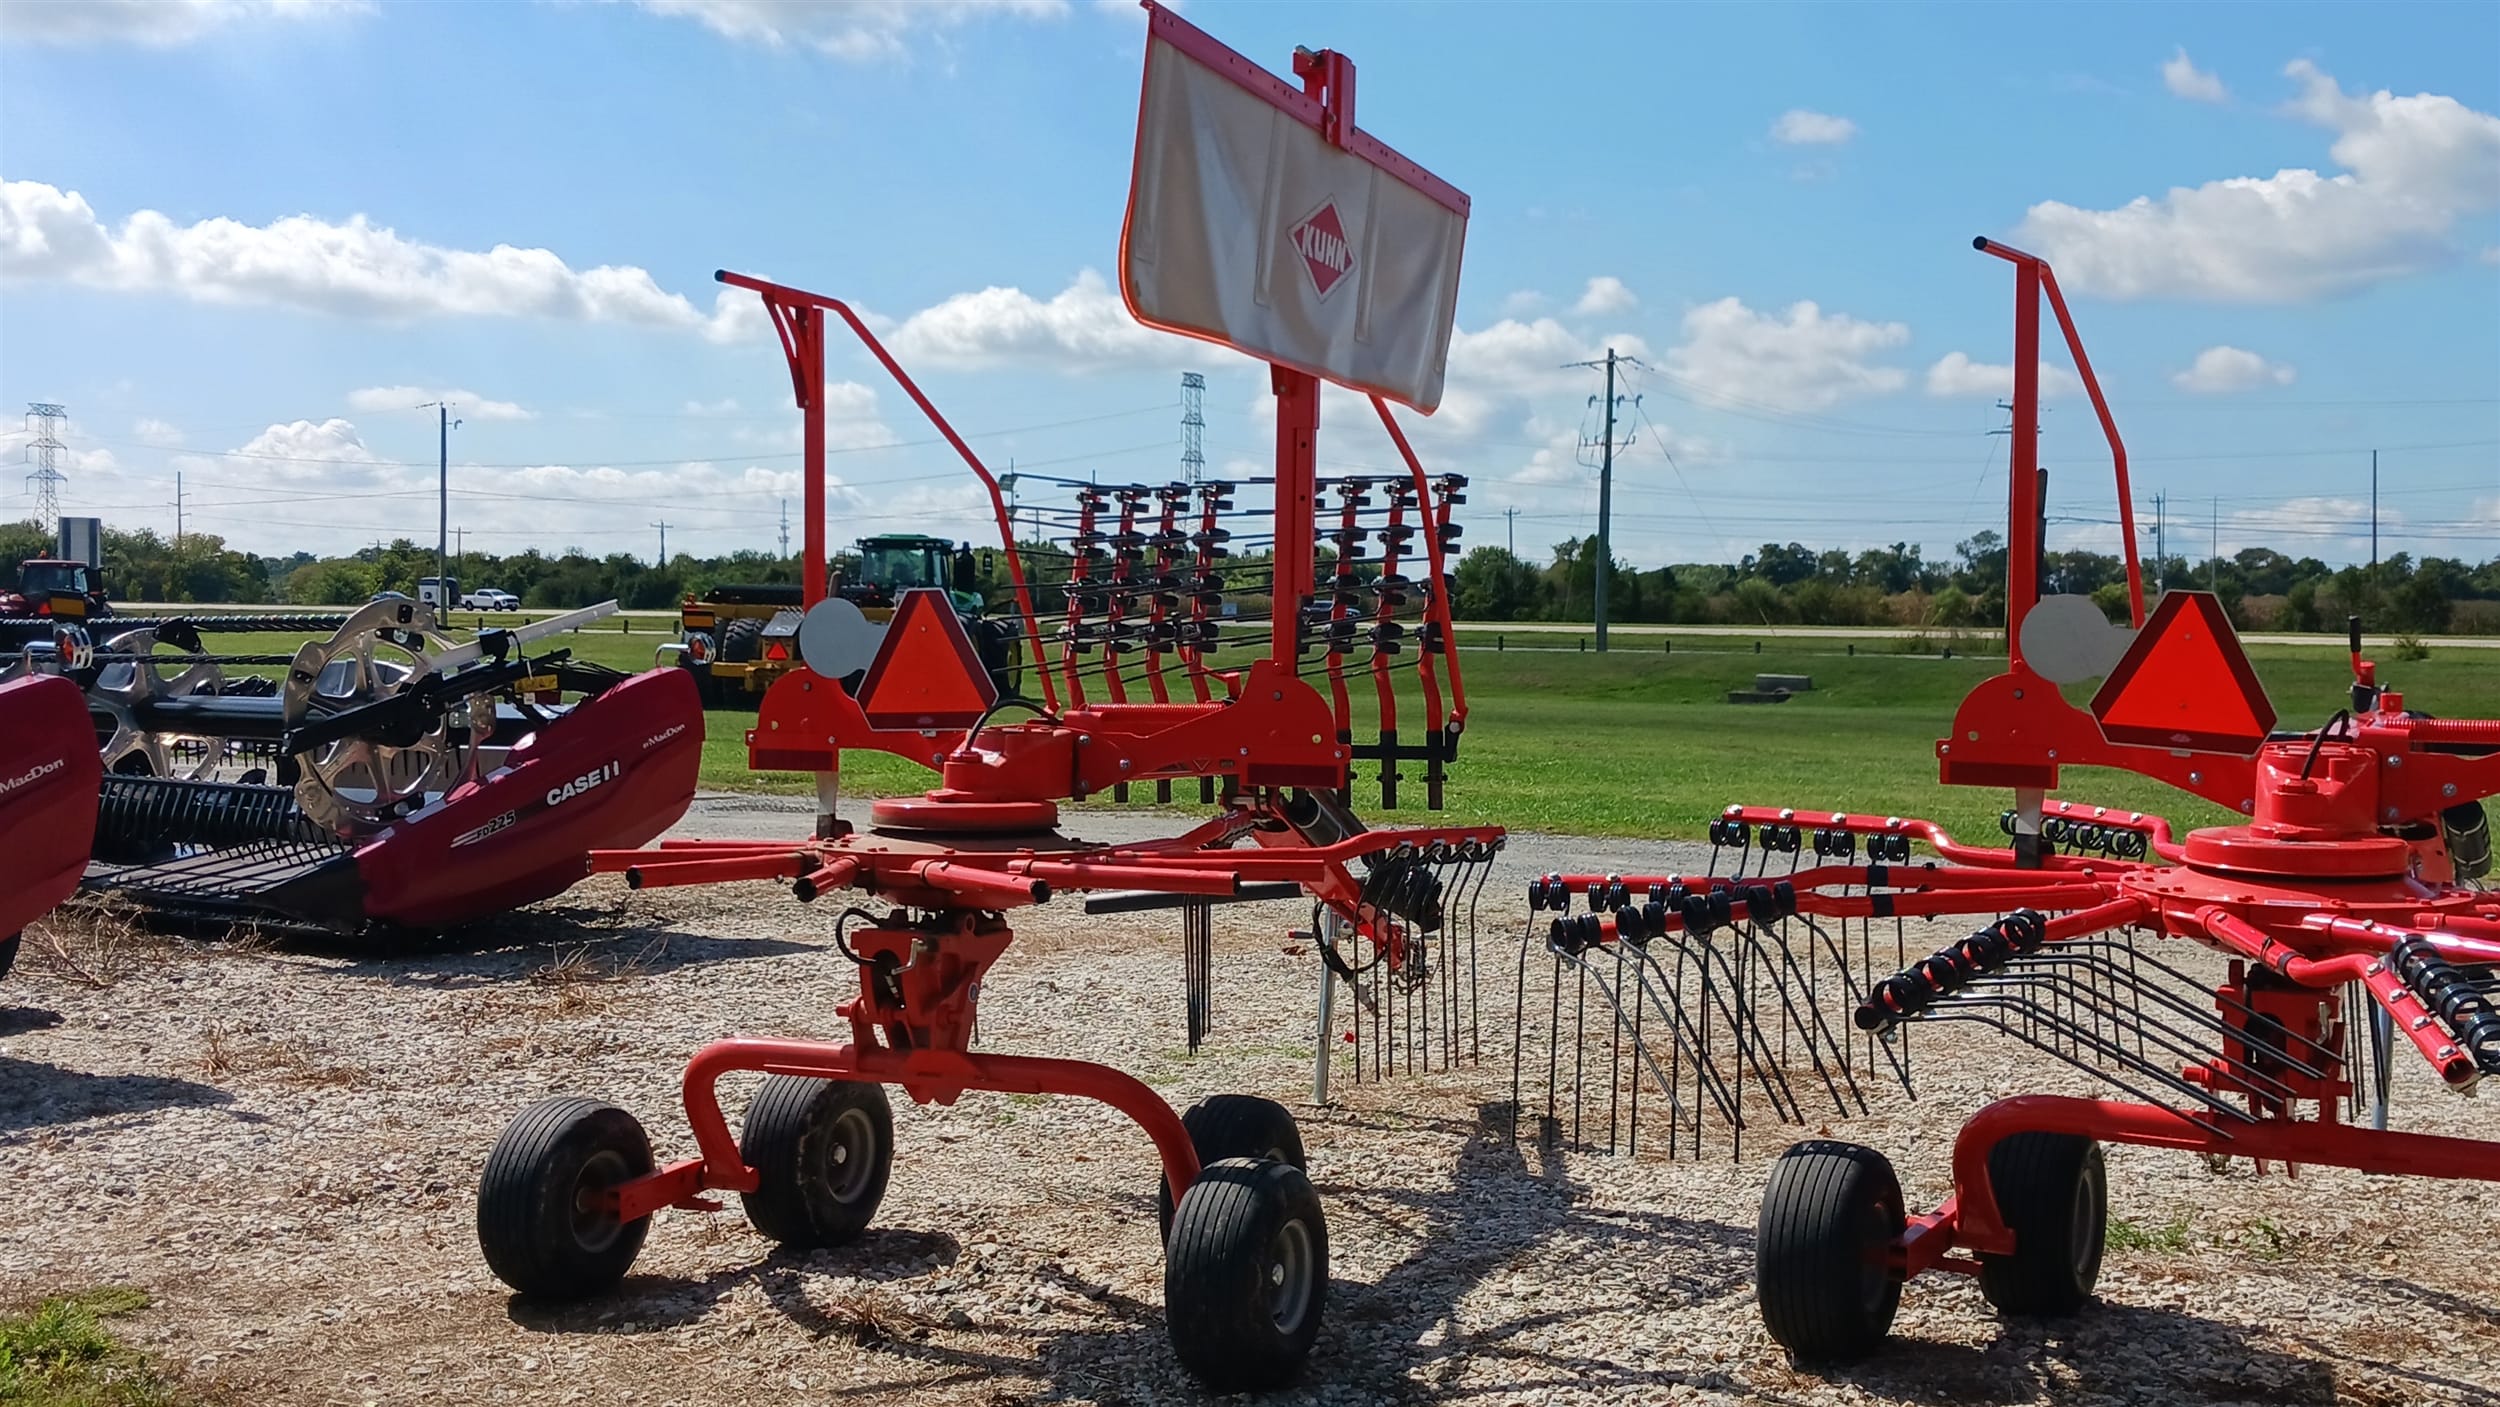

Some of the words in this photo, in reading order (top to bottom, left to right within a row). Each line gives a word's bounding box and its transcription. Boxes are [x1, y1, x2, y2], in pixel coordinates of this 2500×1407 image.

[1302, 223, 1347, 273] KUHN
[0, 759, 65, 794] MacDon
[546, 768, 602, 806] CASE
[477, 809, 517, 839] FD225
